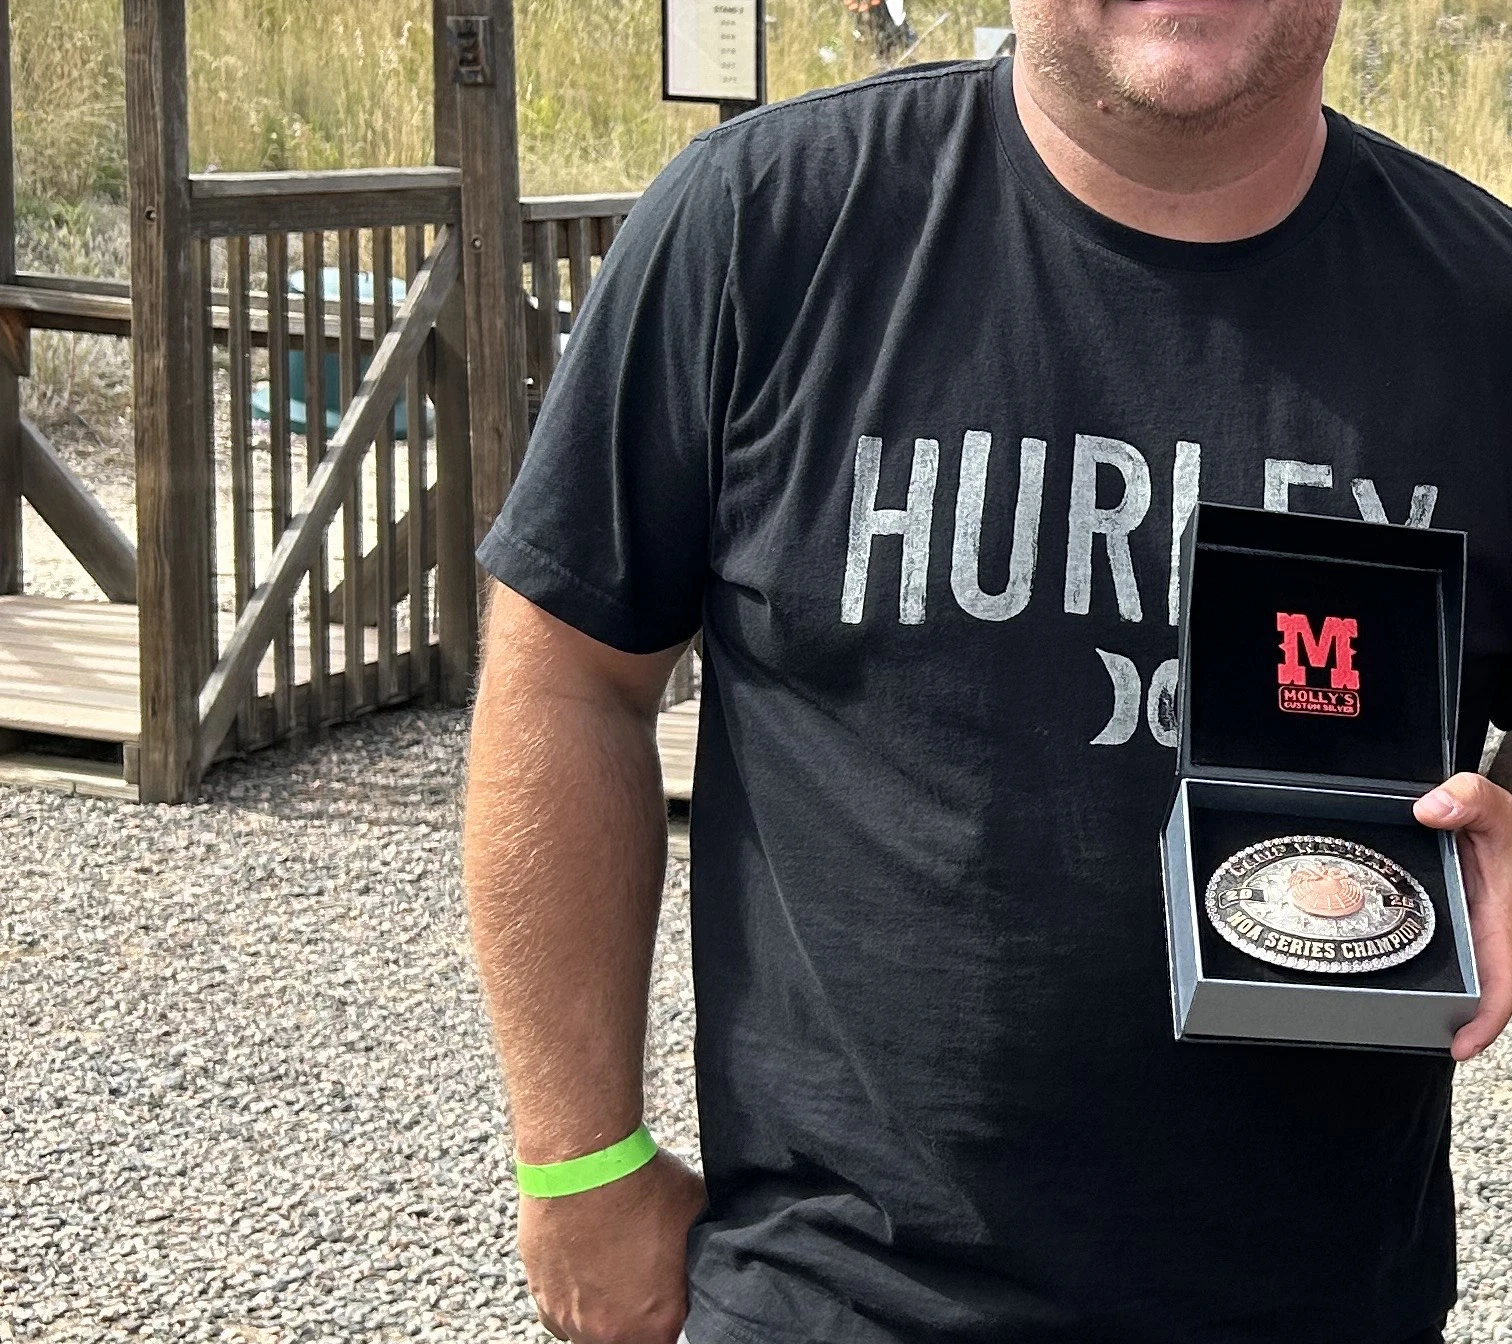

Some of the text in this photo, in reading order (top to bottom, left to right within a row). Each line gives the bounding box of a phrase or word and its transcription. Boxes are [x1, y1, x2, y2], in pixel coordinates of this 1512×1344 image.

[841, 429, 1438, 624] HURL
[1276, 612, 1360, 690] M
[1283, 689, 1355, 706] MOLLY'S
[1283, 701, 1355, 713] CUSTOM SILVER
[1226, 910, 1421, 959] HOA SERIES CHAMPION
